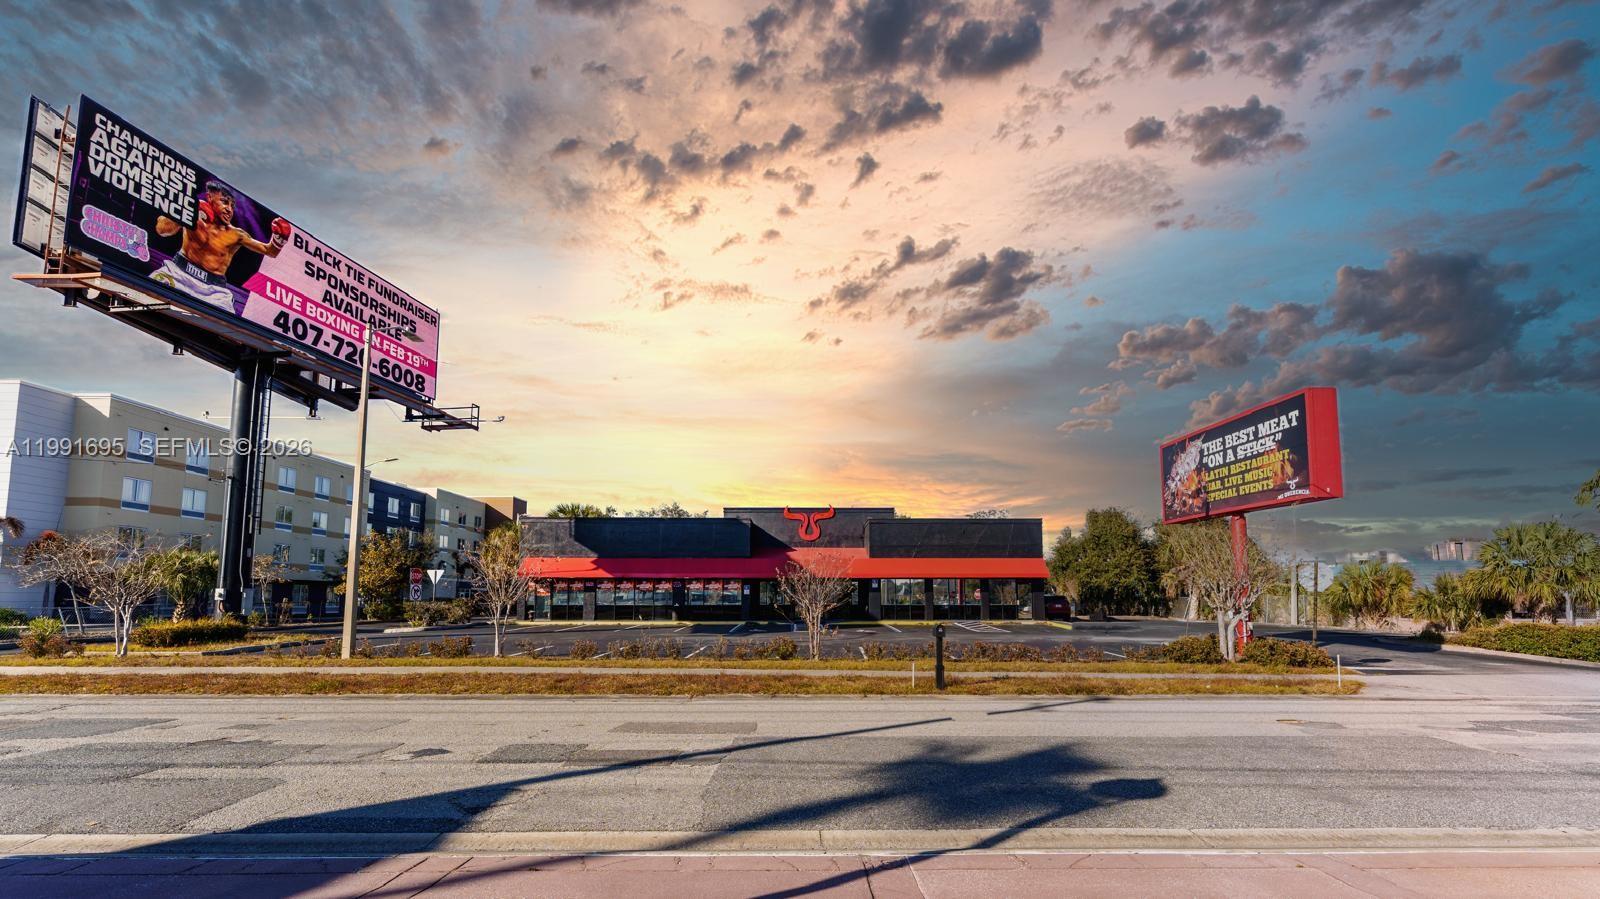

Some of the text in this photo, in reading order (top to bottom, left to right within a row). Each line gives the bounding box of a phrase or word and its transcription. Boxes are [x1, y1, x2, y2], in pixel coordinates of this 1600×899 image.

[89, 141, 195, 211] DOMESTIC
[90, 127, 197, 197] AGAINST
[94, 113, 196, 182] CHAMPIONS
[87, 156, 194, 227] VIOLENCE
[188, 264, 205, 280] TITLE
[293, 233, 437, 327] BLACK TIE FUNDRAISER
[304, 260, 417, 333] SPONSORSHIPS
[265, 282, 302, 311] LIVE
[306, 301, 360, 337] BOXING
[362, 329, 381, 348] N
[382, 339, 405, 360] FEB
[322, 289, 402, 341] AVAILABLE
[1202, 409, 1299, 455] THE BEST MEAT
[1226, 448, 1235, 463] A
[1206, 464, 1229, 481] LATIN
[1207, 479, 1274, 502] SPECIAL EVENTS
[1225, 474, 1243, 487] LIVE
